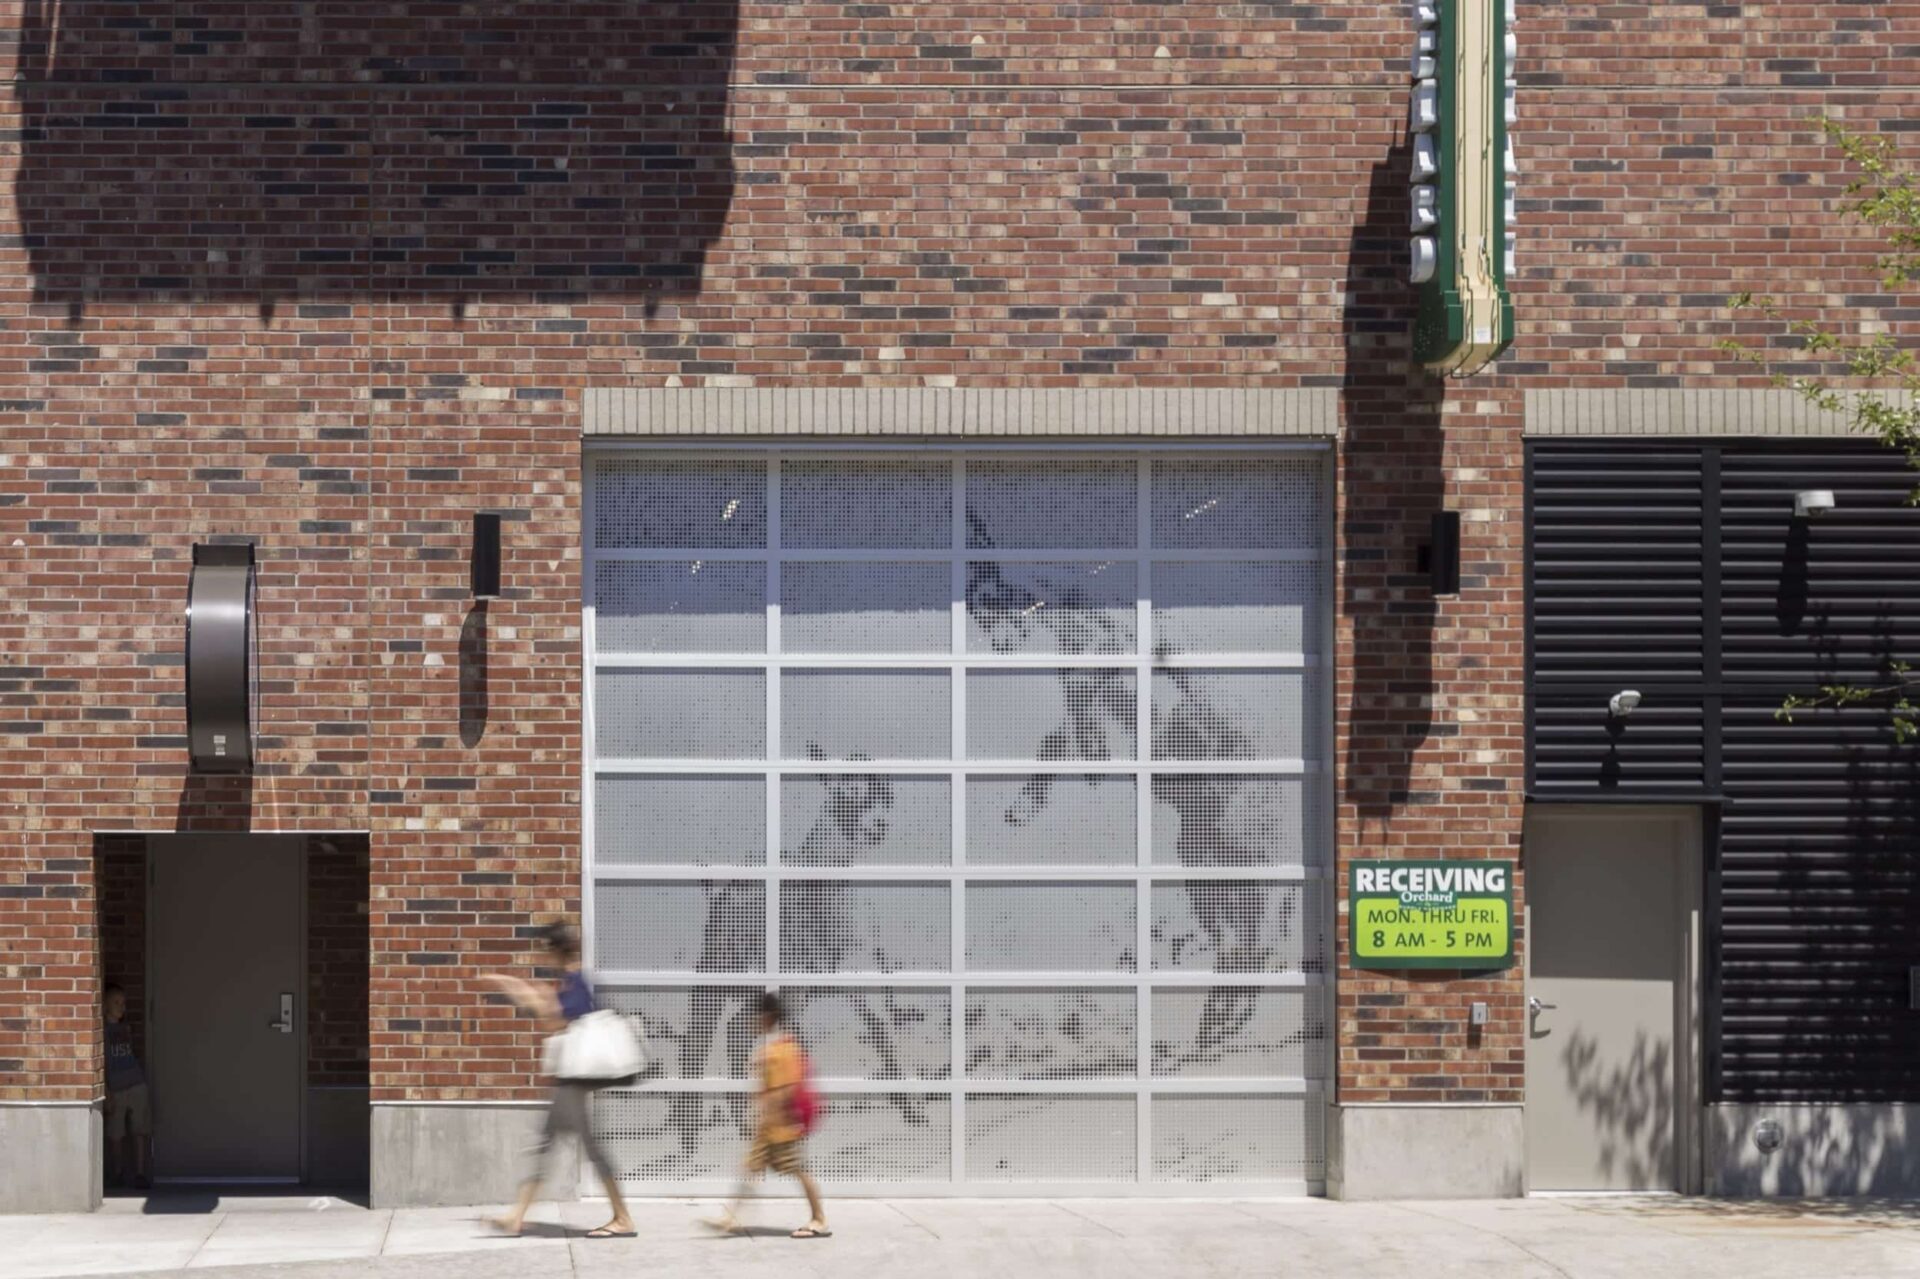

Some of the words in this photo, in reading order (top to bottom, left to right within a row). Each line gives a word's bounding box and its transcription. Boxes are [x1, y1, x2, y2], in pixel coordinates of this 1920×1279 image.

[1356, 868, 1505, 892] RECEIVING
[1401, 890, 1453, 903] Orchard
[1368, 909, 1415, 924] MON.
[1418, 909, 1465, 924] THRU
[1471, 909, 1500, 924] FRI.
[1373, 930, 1385, 948] 8
[1395, 932, 1425, 947] AM
[1446, 930, 1456, 948] 5
[1466, 932, 1492, 947] PM
